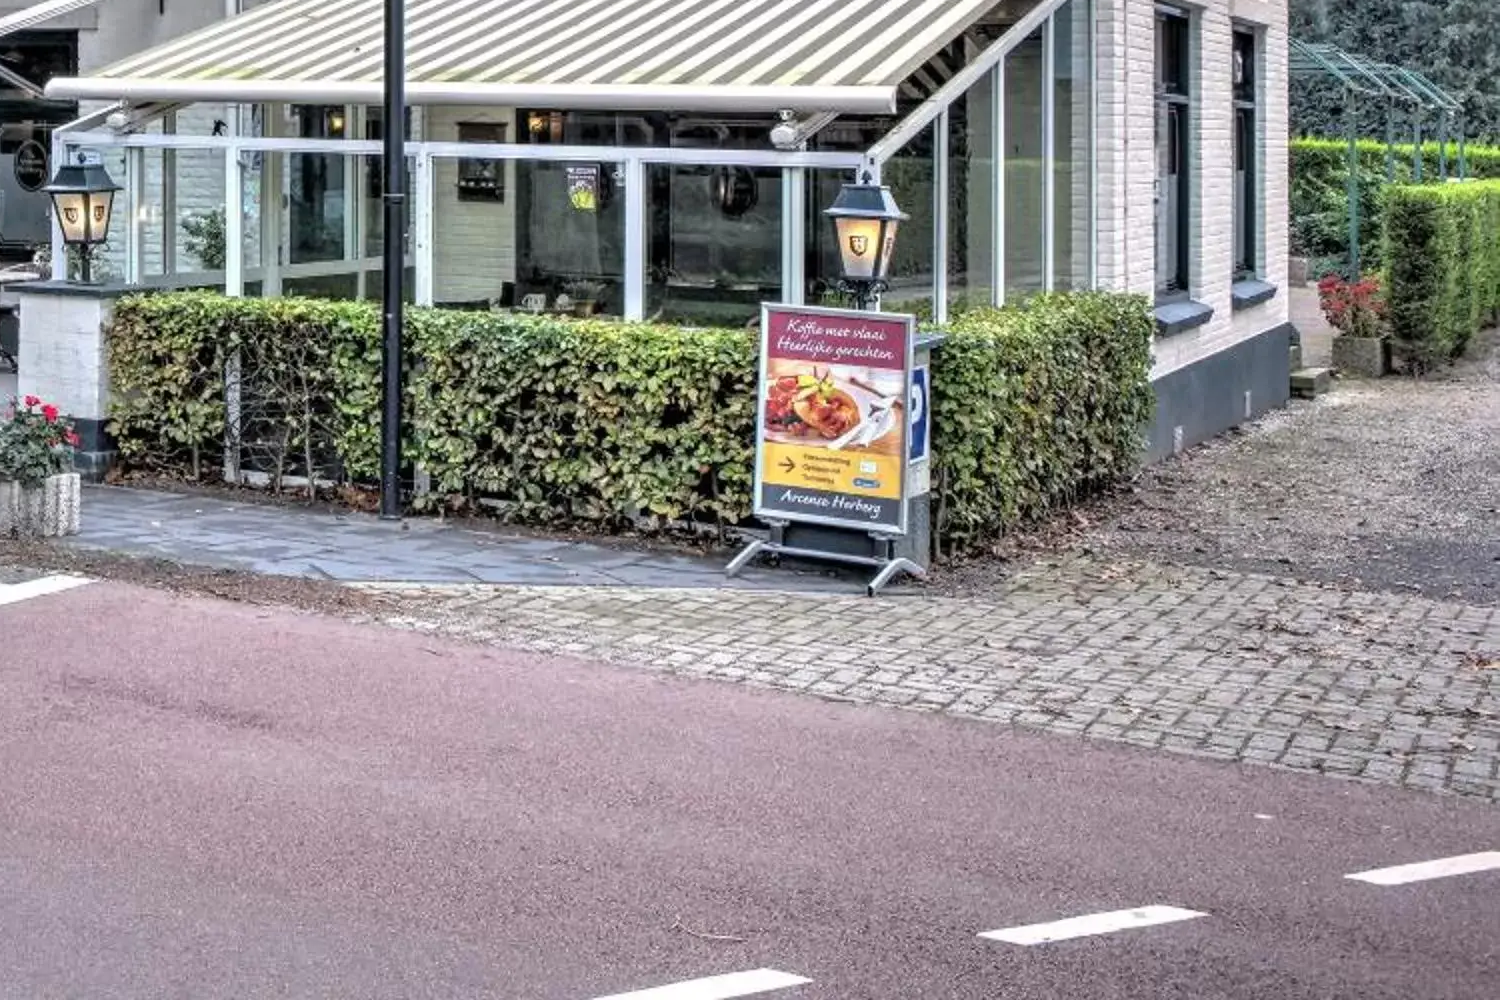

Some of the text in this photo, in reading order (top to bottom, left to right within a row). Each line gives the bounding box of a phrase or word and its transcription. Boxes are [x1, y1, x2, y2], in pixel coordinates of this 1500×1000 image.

[787, 319, 823, 340] Koffie
[825, 326, 851, 338] met
[777, 334, 896, 361] Heerlijke gerechten
[780, 488, 882, 520] Arcense Herberg
